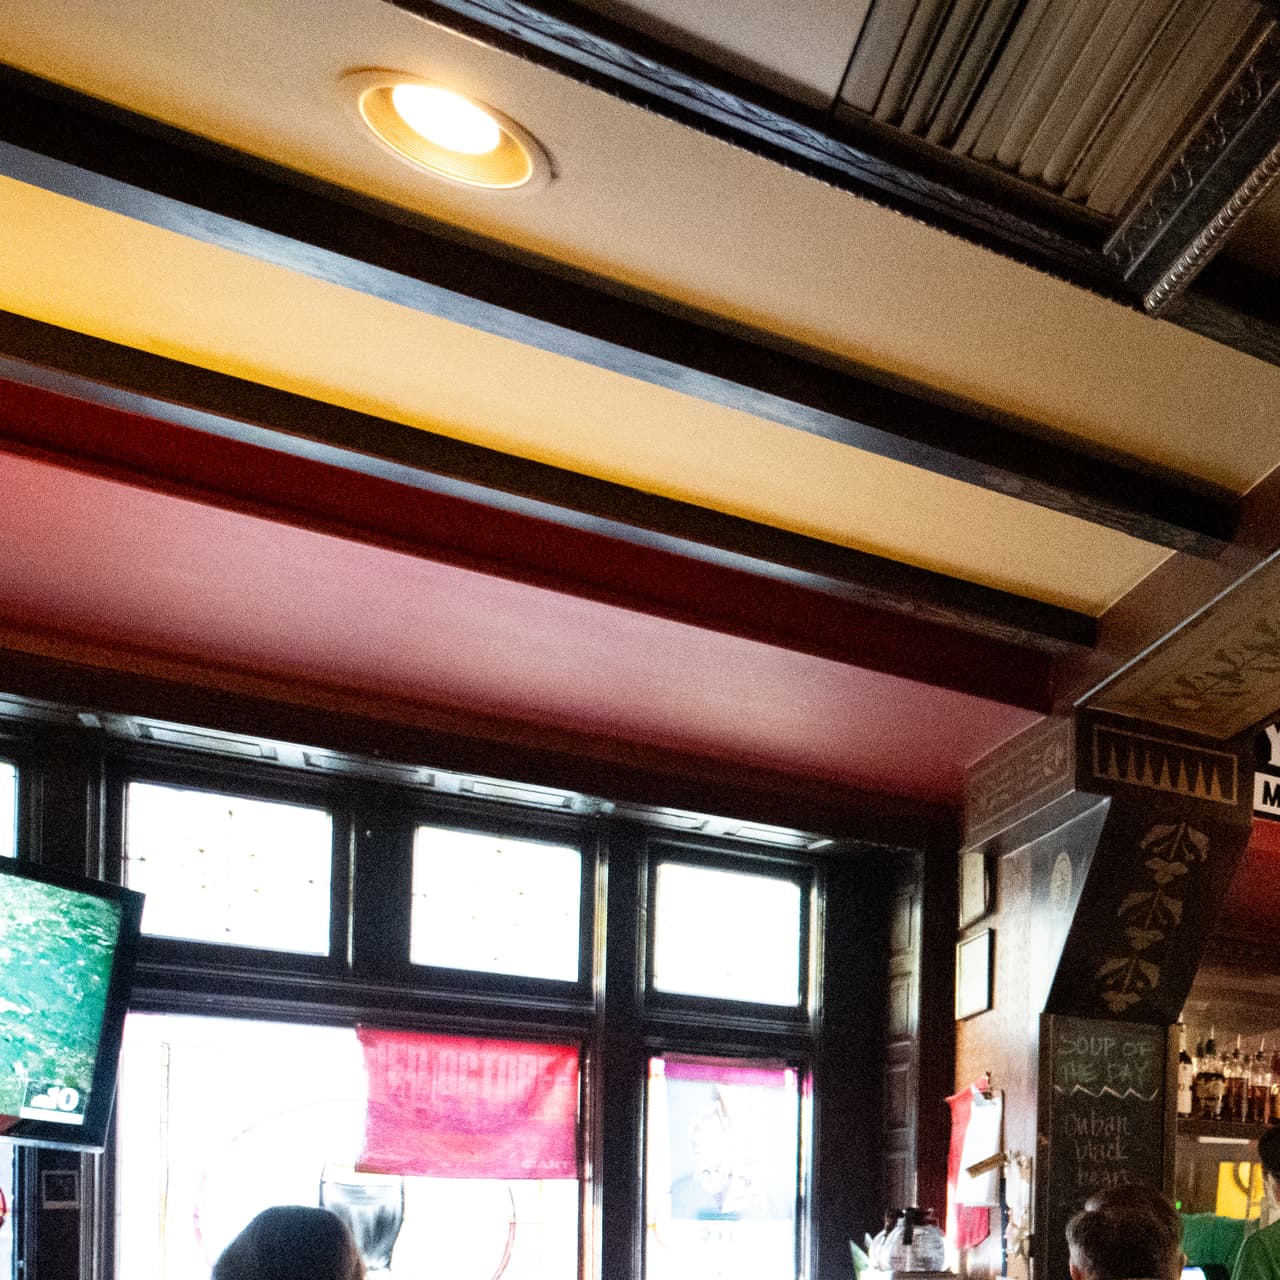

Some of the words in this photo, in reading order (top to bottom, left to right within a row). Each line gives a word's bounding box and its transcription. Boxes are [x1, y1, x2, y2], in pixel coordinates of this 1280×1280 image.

[1057, 1035, 1116, 1057] SOUP
[1122, 1041, 1153, 1056] OF
[1063, 1062, 1097, 1084] THE
[1107, 1061, 1149, 1086] DAY
